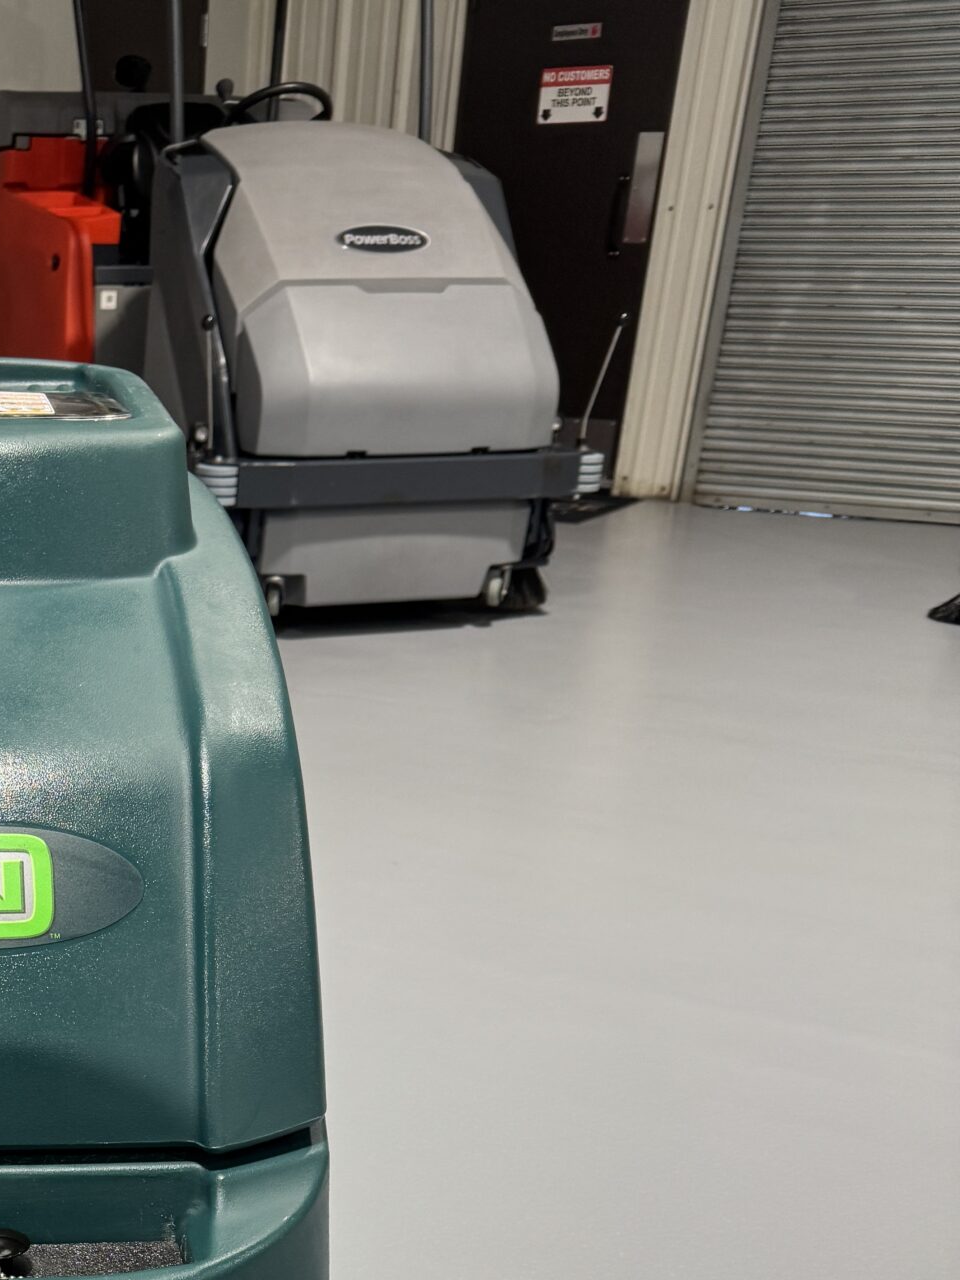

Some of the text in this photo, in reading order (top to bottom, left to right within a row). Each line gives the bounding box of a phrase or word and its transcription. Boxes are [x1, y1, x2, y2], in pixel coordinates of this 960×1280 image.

[543, 69, 611, 83] NO CUSTOMERS
[557, 86, 593, 98] BEYOND
[551, 96, 597, 108] THIS POINT
[343, 233, 422, 246] PowerBoss
